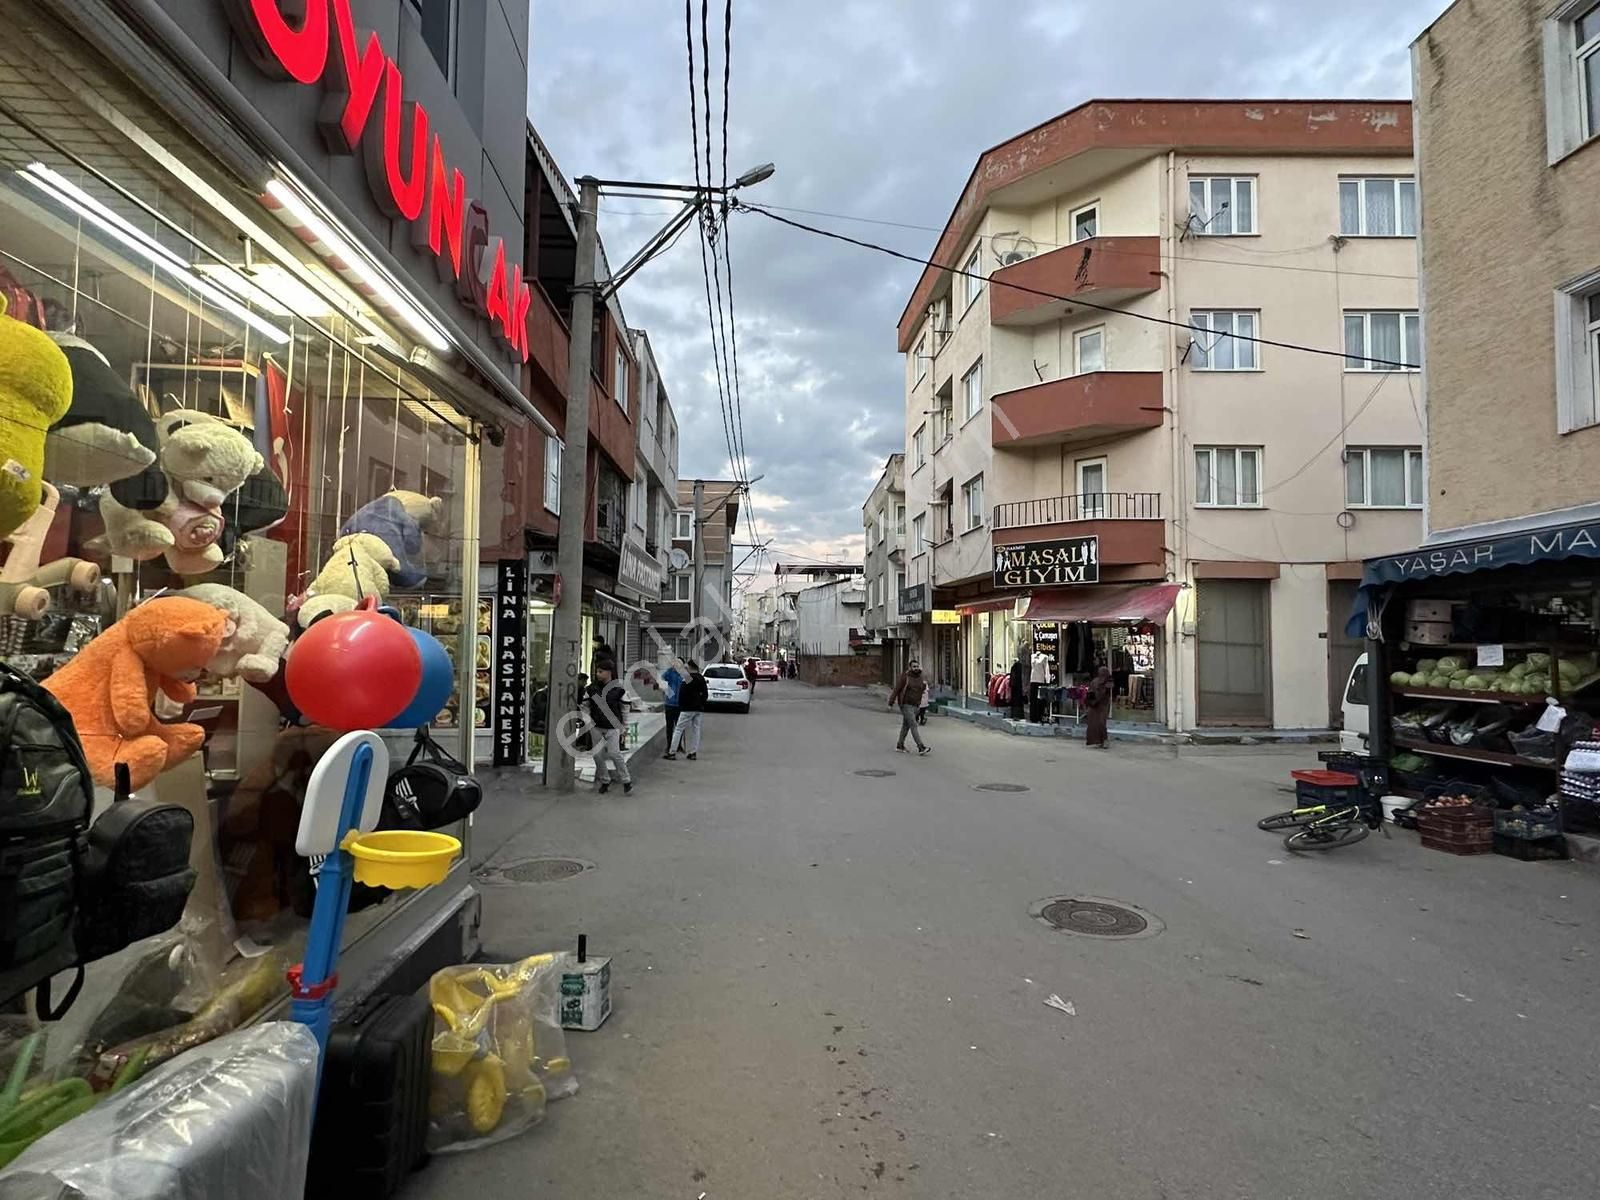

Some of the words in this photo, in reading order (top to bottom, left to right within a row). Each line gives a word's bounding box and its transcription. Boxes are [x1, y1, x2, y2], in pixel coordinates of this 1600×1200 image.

[1011, 546, 1084, 568] MASAL
[1395, 544, 1493, 576] YAŞAR
[1004, 564, 1086, 585] GİYİM
[502, 566, 517, 619] LİNA
[1036, 642, 1056, 651] Elbise
[500, 636, 515, 758] PASTANESİ
